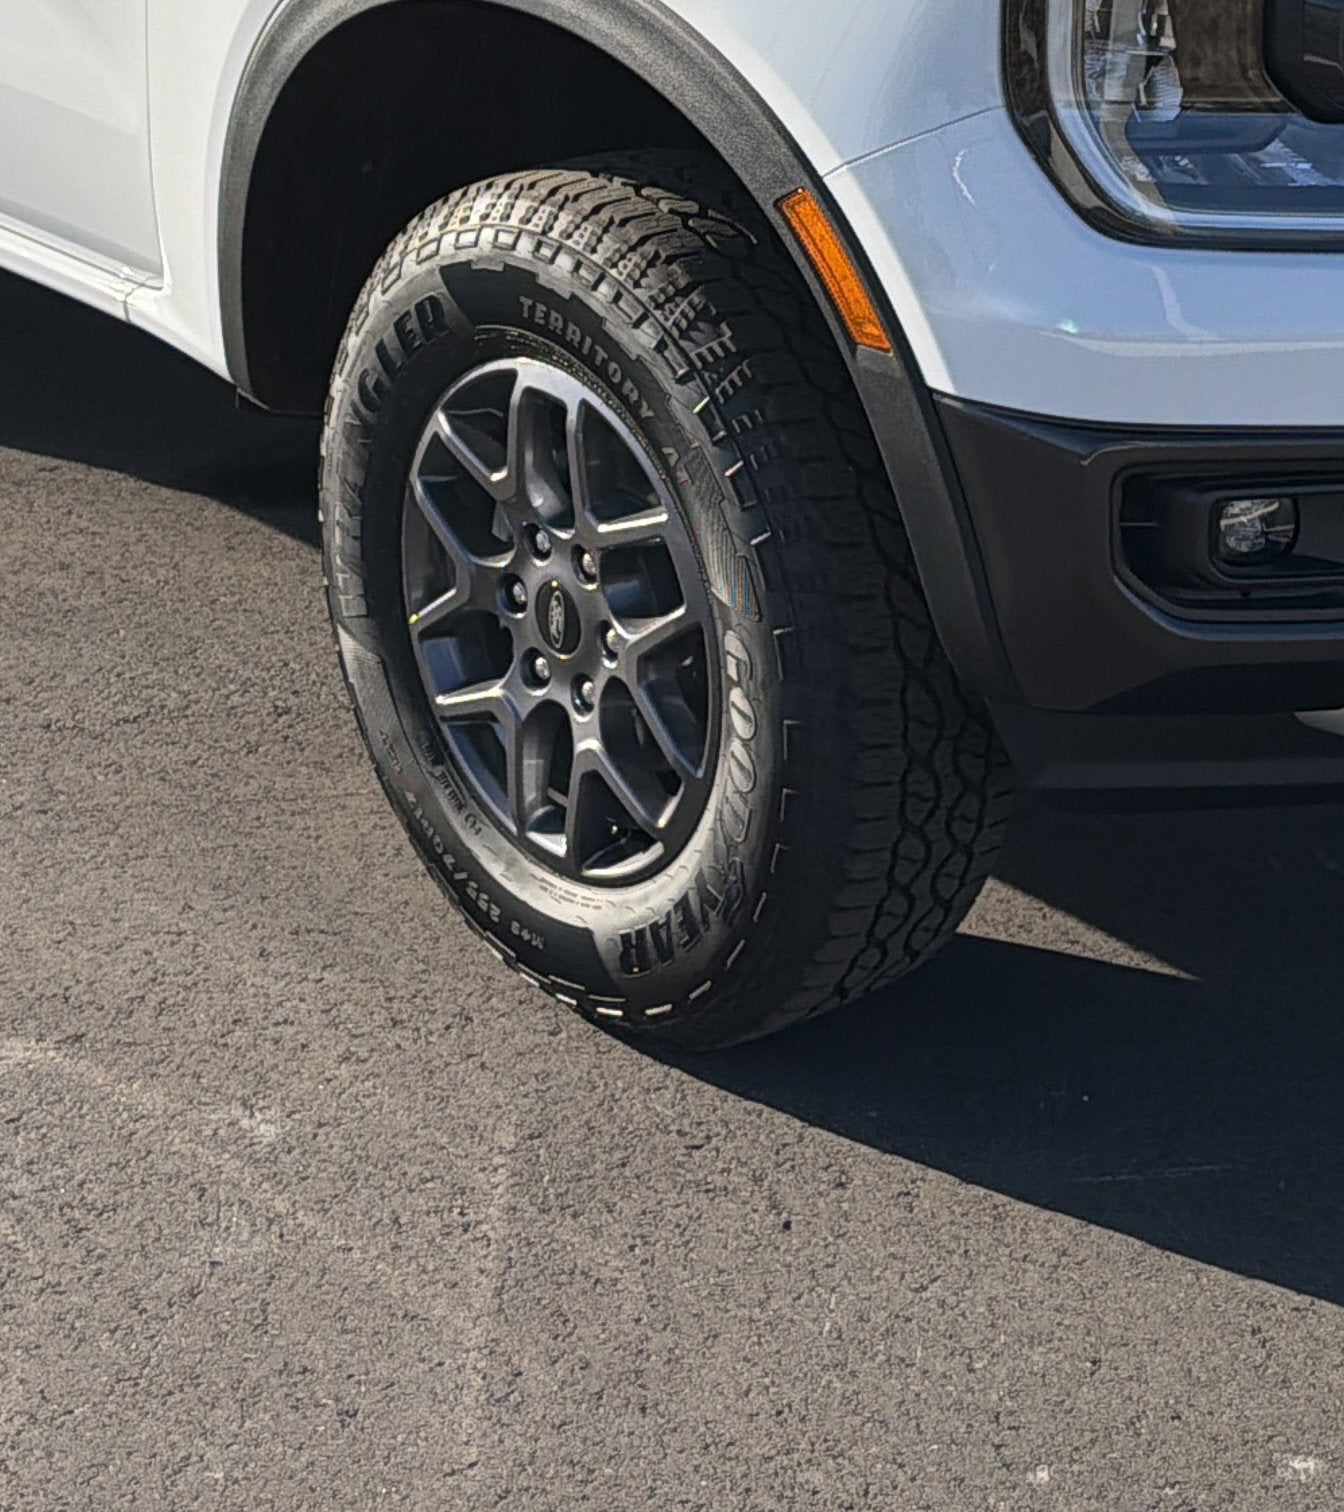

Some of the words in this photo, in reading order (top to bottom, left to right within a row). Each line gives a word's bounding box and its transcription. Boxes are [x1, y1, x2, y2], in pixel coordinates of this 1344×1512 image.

[335, 294, 451, 618] WRANGLER
[519, 295, 655, 418] TERRITORY
[619, 629, 758, 979] GOODYEAR
